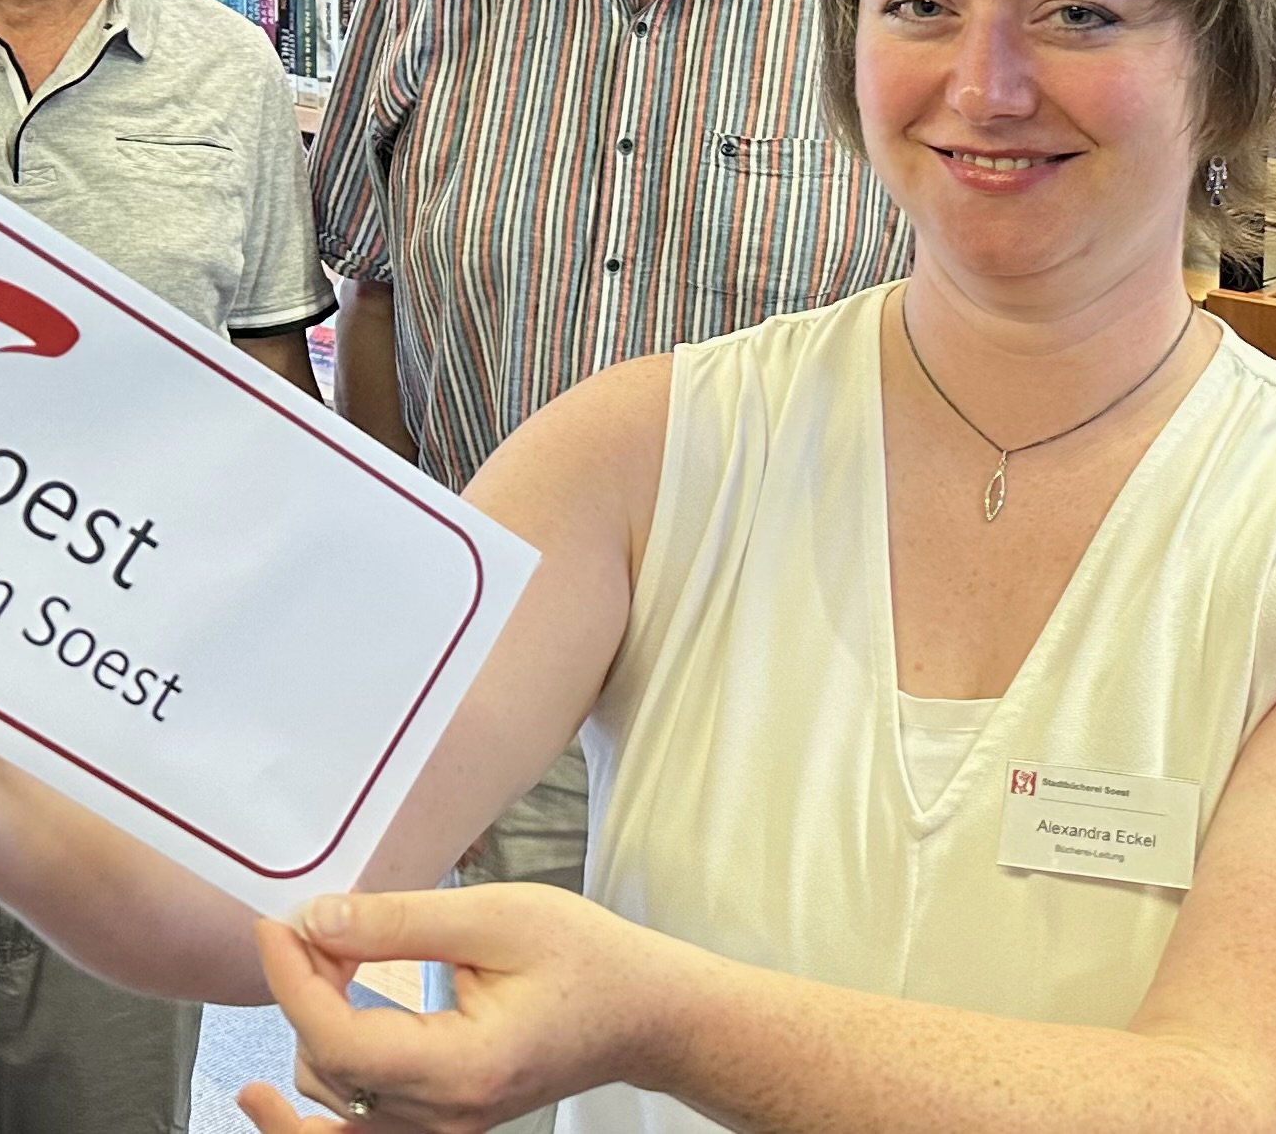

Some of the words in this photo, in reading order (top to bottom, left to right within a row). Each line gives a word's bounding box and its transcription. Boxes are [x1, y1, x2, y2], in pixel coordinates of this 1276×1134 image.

[22, 596, 183, 723] Soest
[1036, 819, 1111, 842] Alexandra
[1115, 829, 1156, 848] Eckel
